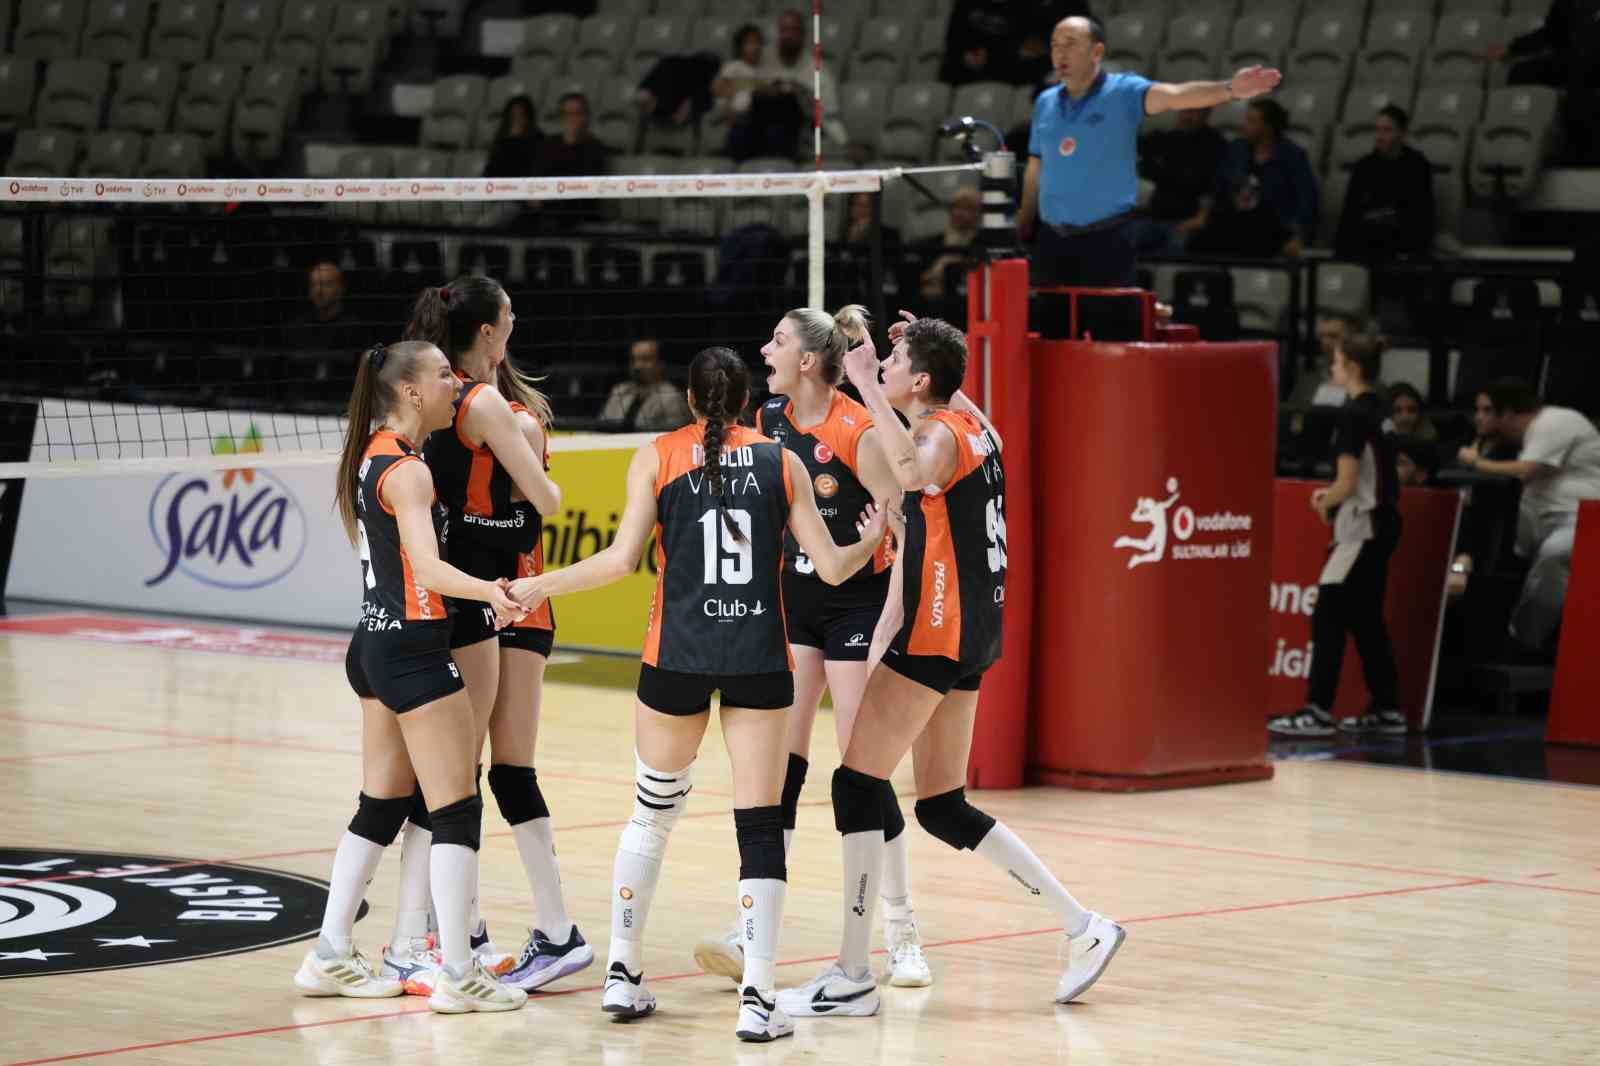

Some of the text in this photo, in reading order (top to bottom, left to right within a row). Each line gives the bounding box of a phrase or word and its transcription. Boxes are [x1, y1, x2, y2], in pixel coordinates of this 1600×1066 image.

[1195, 510, 1252, 532] vodafone
[696, 508, 754, 586] 19
[703, 598, 748, 617] Club
[930, 559, 945, 629] PEGASUS
